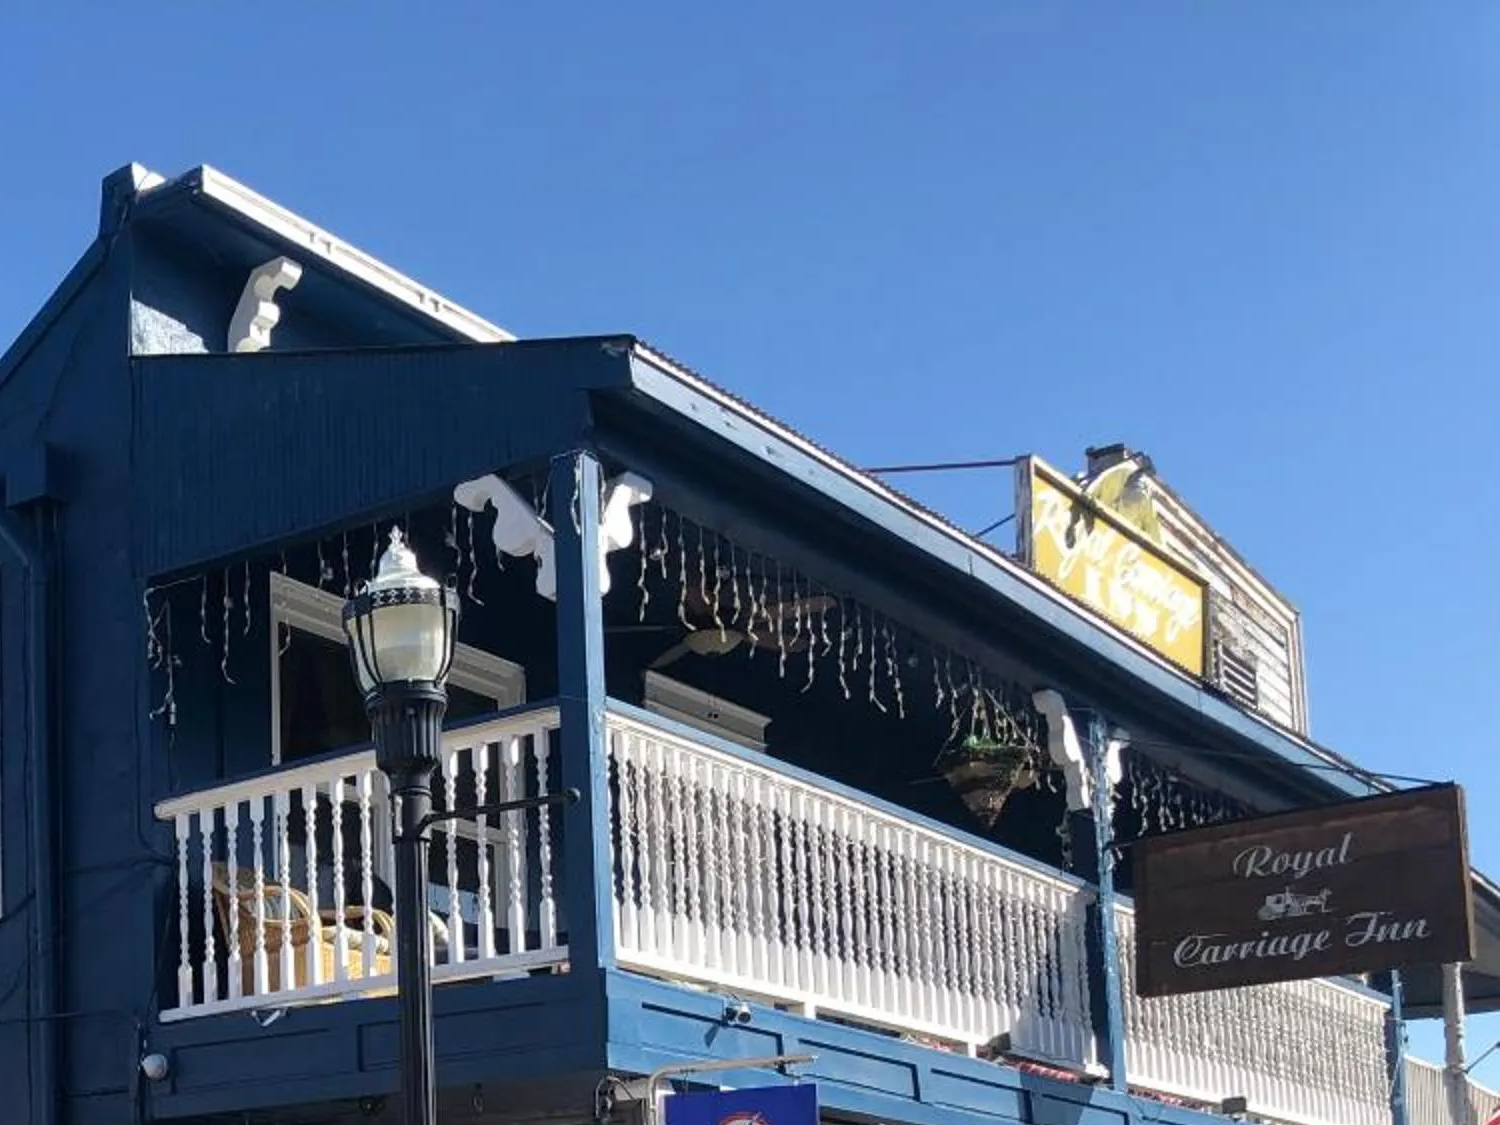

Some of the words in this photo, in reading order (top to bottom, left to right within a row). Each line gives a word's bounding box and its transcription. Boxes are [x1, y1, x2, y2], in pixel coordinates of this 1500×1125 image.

[1232, 832, 1354, 879] Royal
[1173, 930, 1332, 968] Carriage
[1345, 911, 1431, 947] Inn
